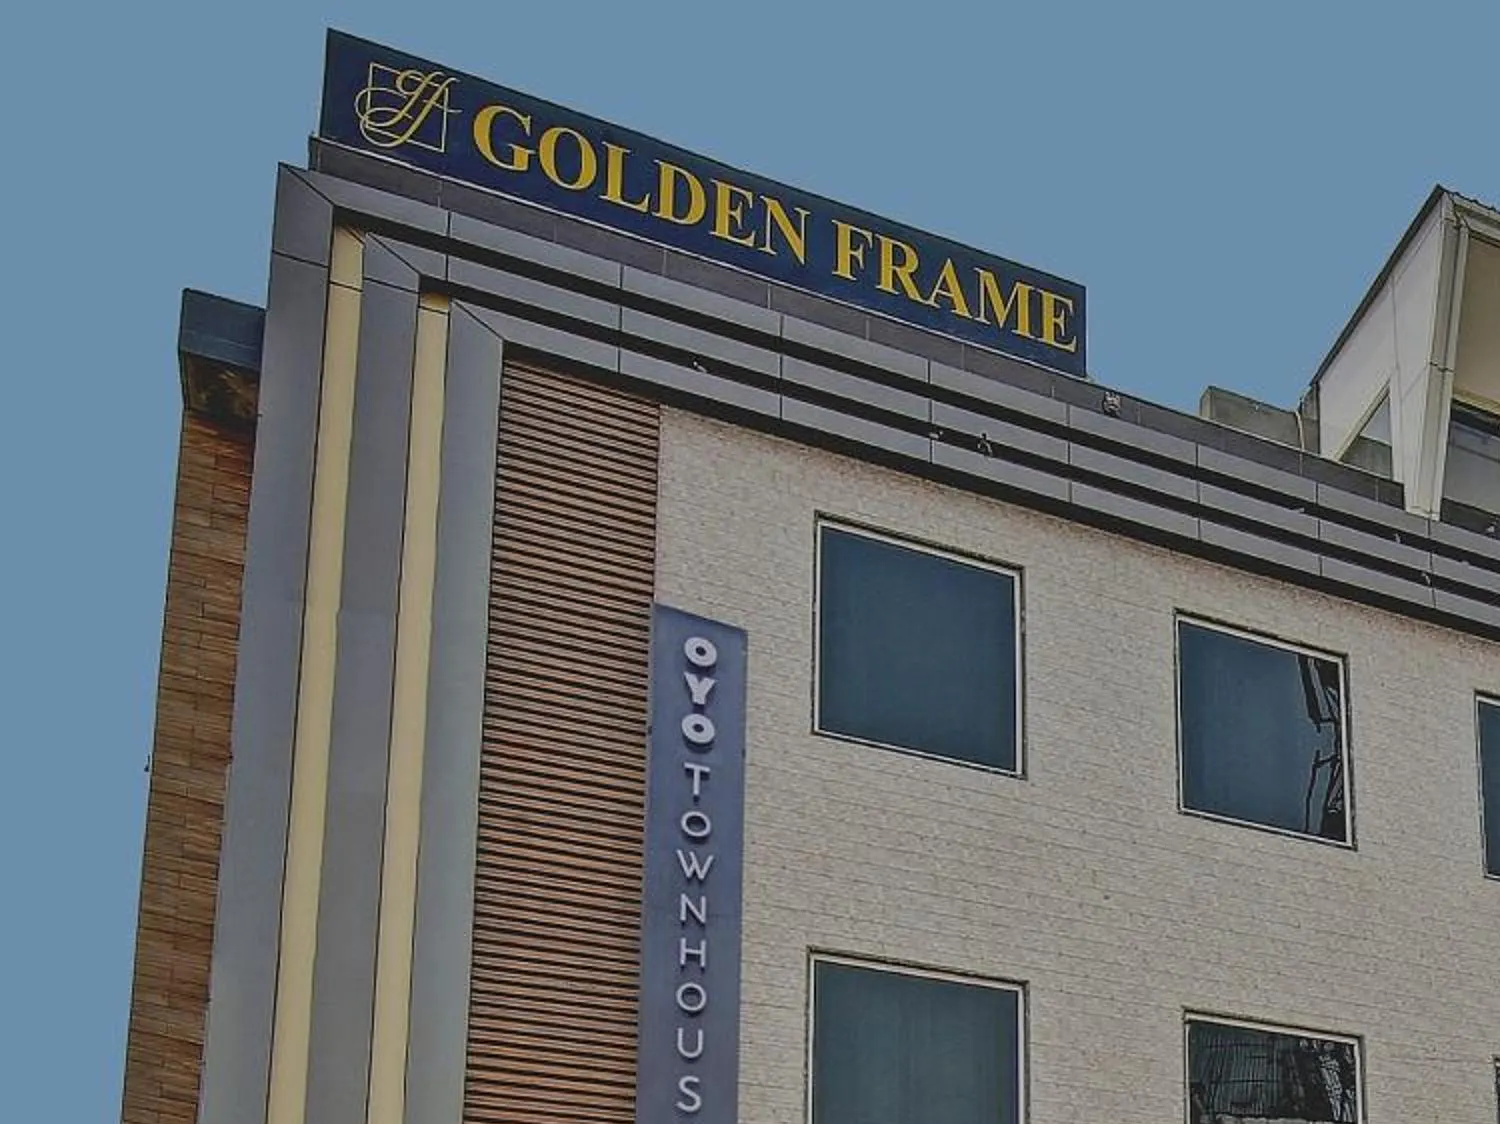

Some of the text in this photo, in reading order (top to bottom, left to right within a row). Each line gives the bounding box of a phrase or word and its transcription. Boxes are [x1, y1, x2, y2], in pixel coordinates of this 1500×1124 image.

[472, 104, 809, 265] GOLDEN
[831, 218, 1078, 353] FRAME
[682, 636, 718, 743] OYO
